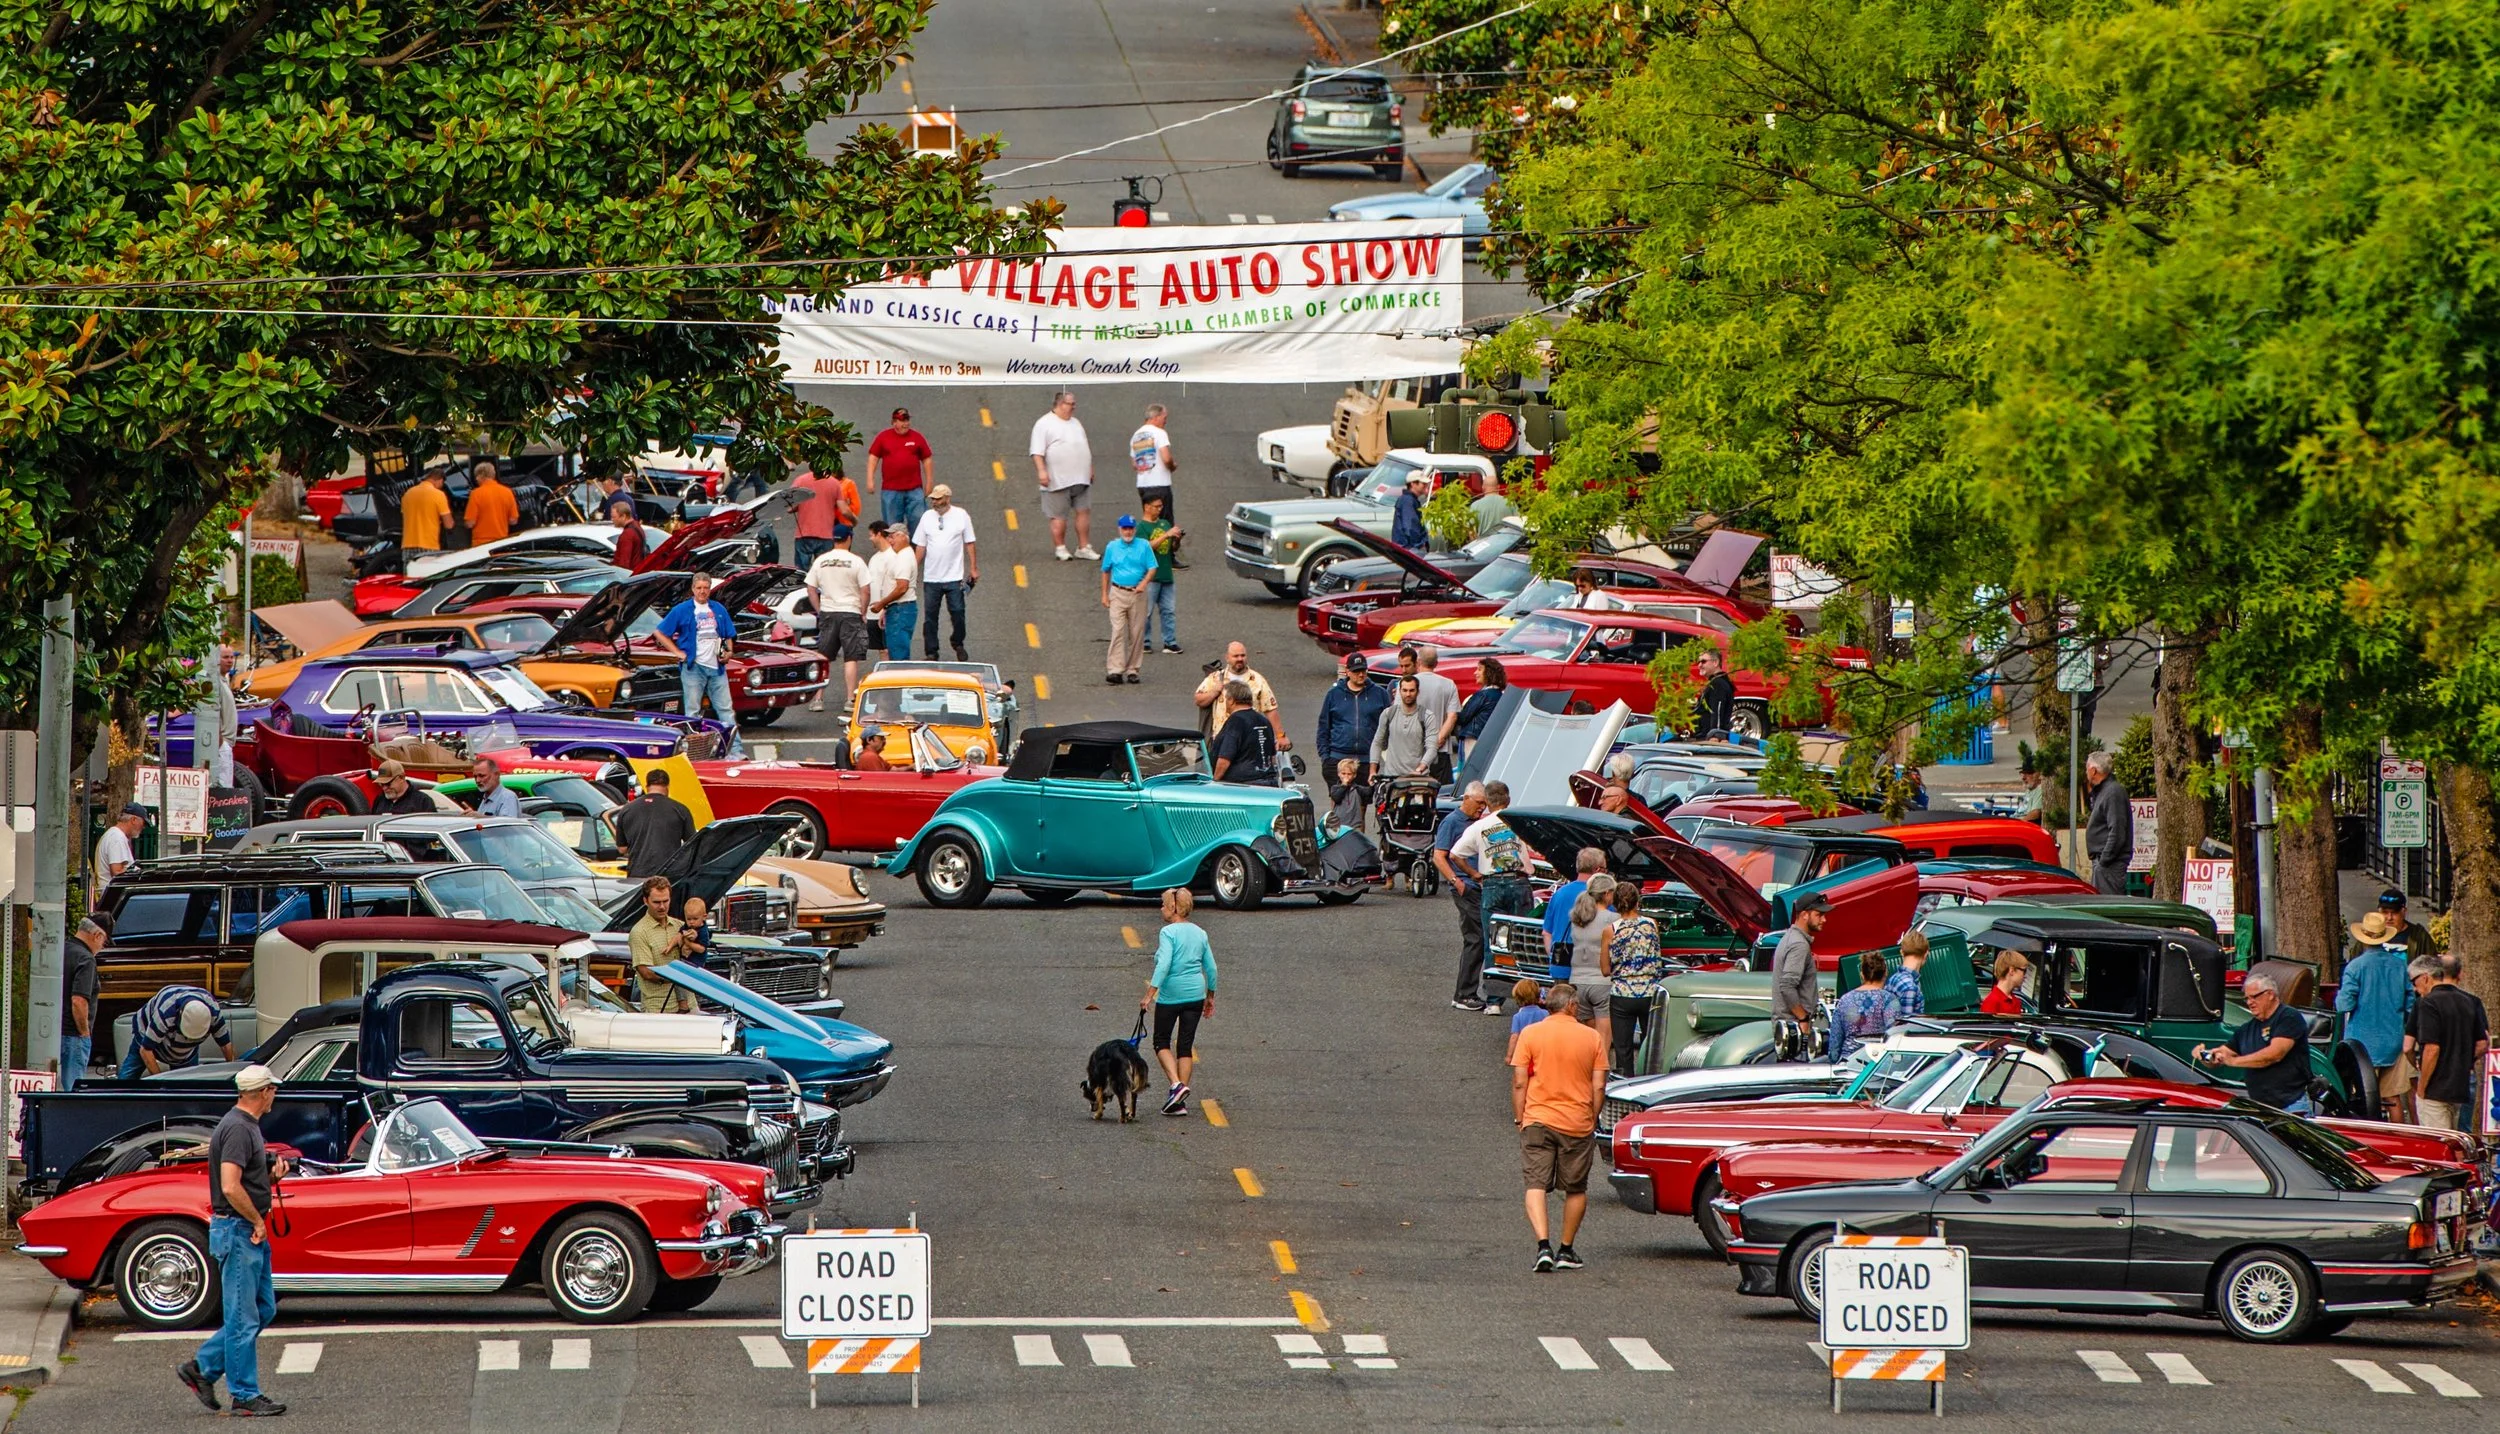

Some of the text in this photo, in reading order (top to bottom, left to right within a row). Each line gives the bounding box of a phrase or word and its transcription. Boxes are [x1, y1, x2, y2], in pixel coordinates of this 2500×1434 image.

[956, 249, 1139, 309] VILLAGE
[1160, 251, 1281, 307] AUTO
[1302, 232, 1442, 289] SHOW
[766, 298, 1019, 334] NTAG AND CLASSIC CARS
[1051, 291, 1441, 341] THE MAGOLIA CHAMBER OF COMMERCE
[814, 359, 982, 376] AUGUST 12TH 9AM TO 3PM
[1006, 357, 1181, 378] Werners Crash Shop
[250, 542, 294, 552] PARKING
[1773, 558, 1791, 571] NO
[143, 772, 200, 787] PAKING
[174, 811, 198, 820] AREA
[2188, 862, 2211, 880] NO
[2198, 896, 2206, 904] TO
[817, 1251, 896, 1278] ROAD
[1859, 1262, 1930, 1290] ROAD
[798, 1294, 914, 1322] CLOSED
[1842, 1304, 1948, 1332] CLOSED
